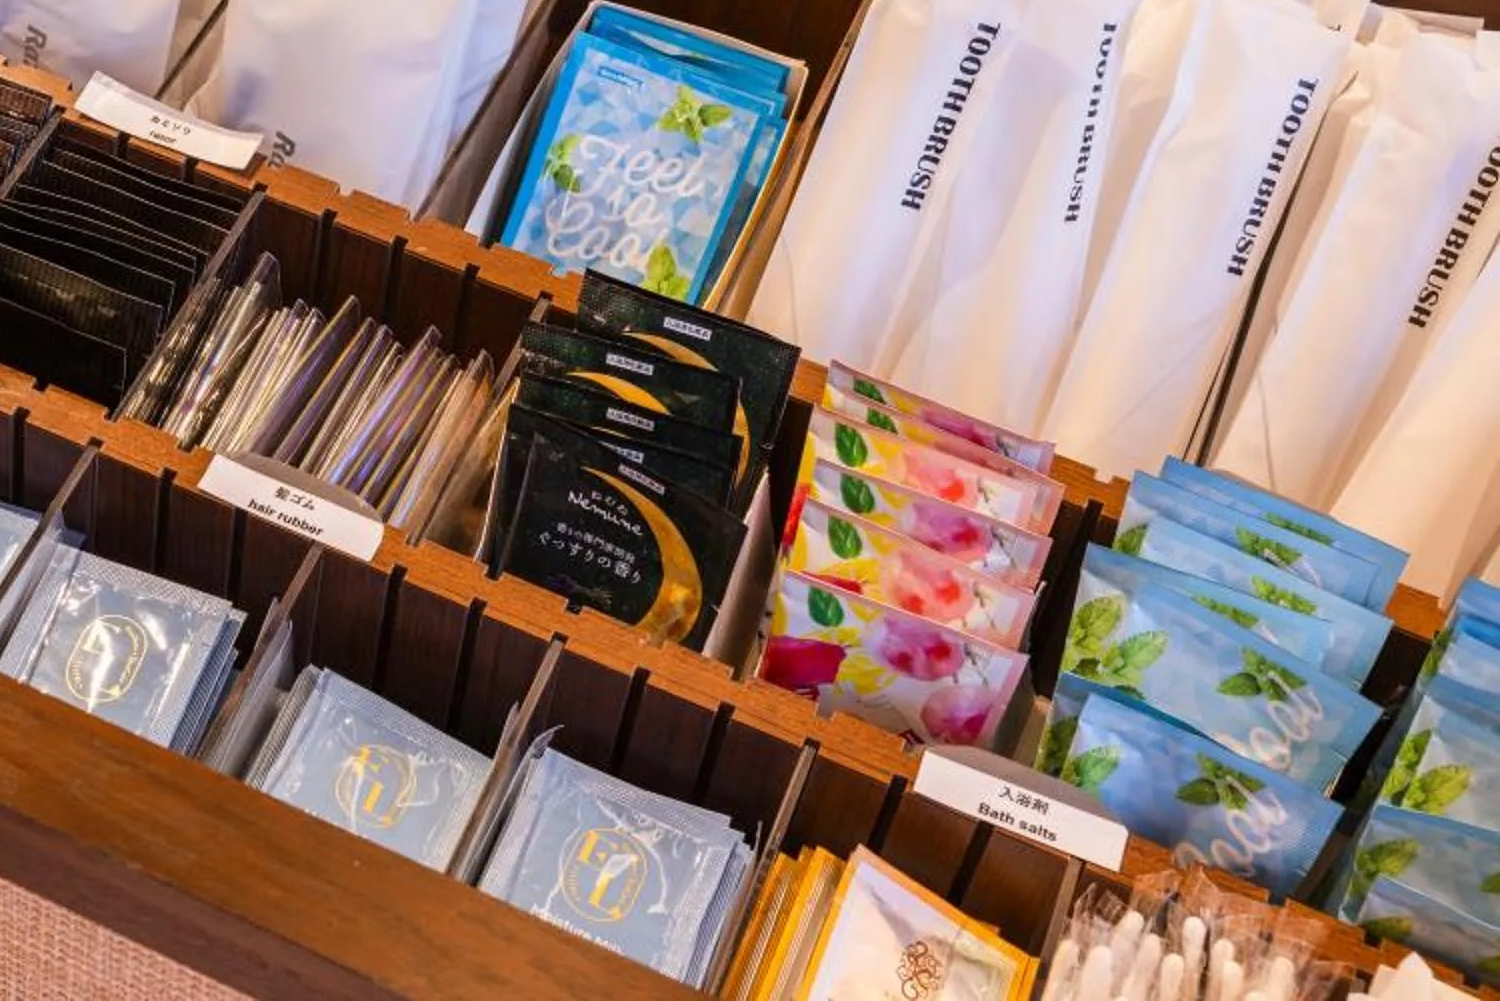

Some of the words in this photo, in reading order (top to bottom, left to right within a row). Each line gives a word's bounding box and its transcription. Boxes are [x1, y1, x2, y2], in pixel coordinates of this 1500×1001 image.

[943, 21, 1002, 114] TOOTH
[1265, 78, 1319, 175] TOOTH
[900, 115, 958, 212] BRUSH
[1226, 176, 1278, 278] BRUSH
[1407, 226, 1470, 329] BRUSH
[247, 498, 277, 516] hair
[277, 512, 325, 536] rubber
[275, 486, 315, 511] 髪ゴム
[567, 490, 643, 536] Nemune
[978, 801, 1015, 826] Bath
[1019, 820, 1058, 842] salts
[999, 786, 1049, 815] 入浴剤
